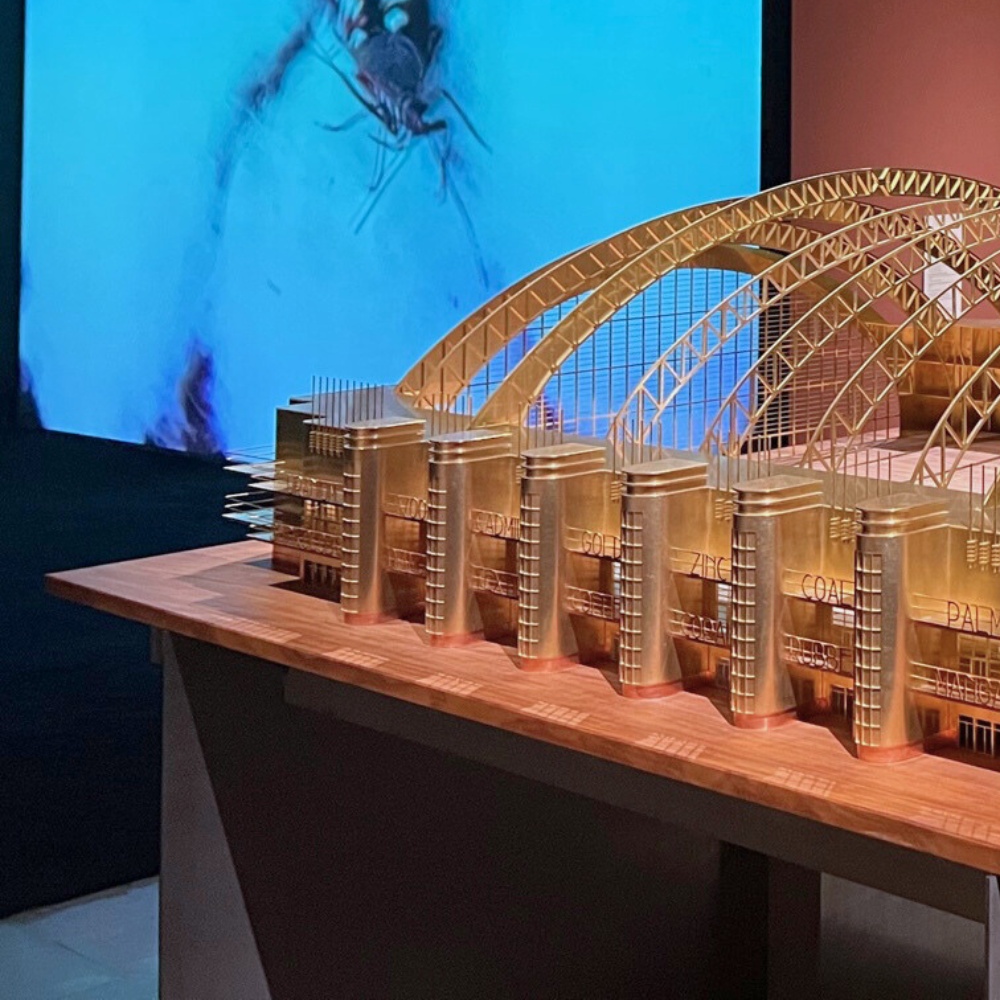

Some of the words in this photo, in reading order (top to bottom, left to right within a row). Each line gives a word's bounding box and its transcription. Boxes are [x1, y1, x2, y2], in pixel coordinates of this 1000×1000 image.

[581, 531, 621, 561] GOLD
[690, 552, 729, 582] ZINC
[801, 573, 853, 608] COAL
[787, 635, 853, 677] RUBBE
